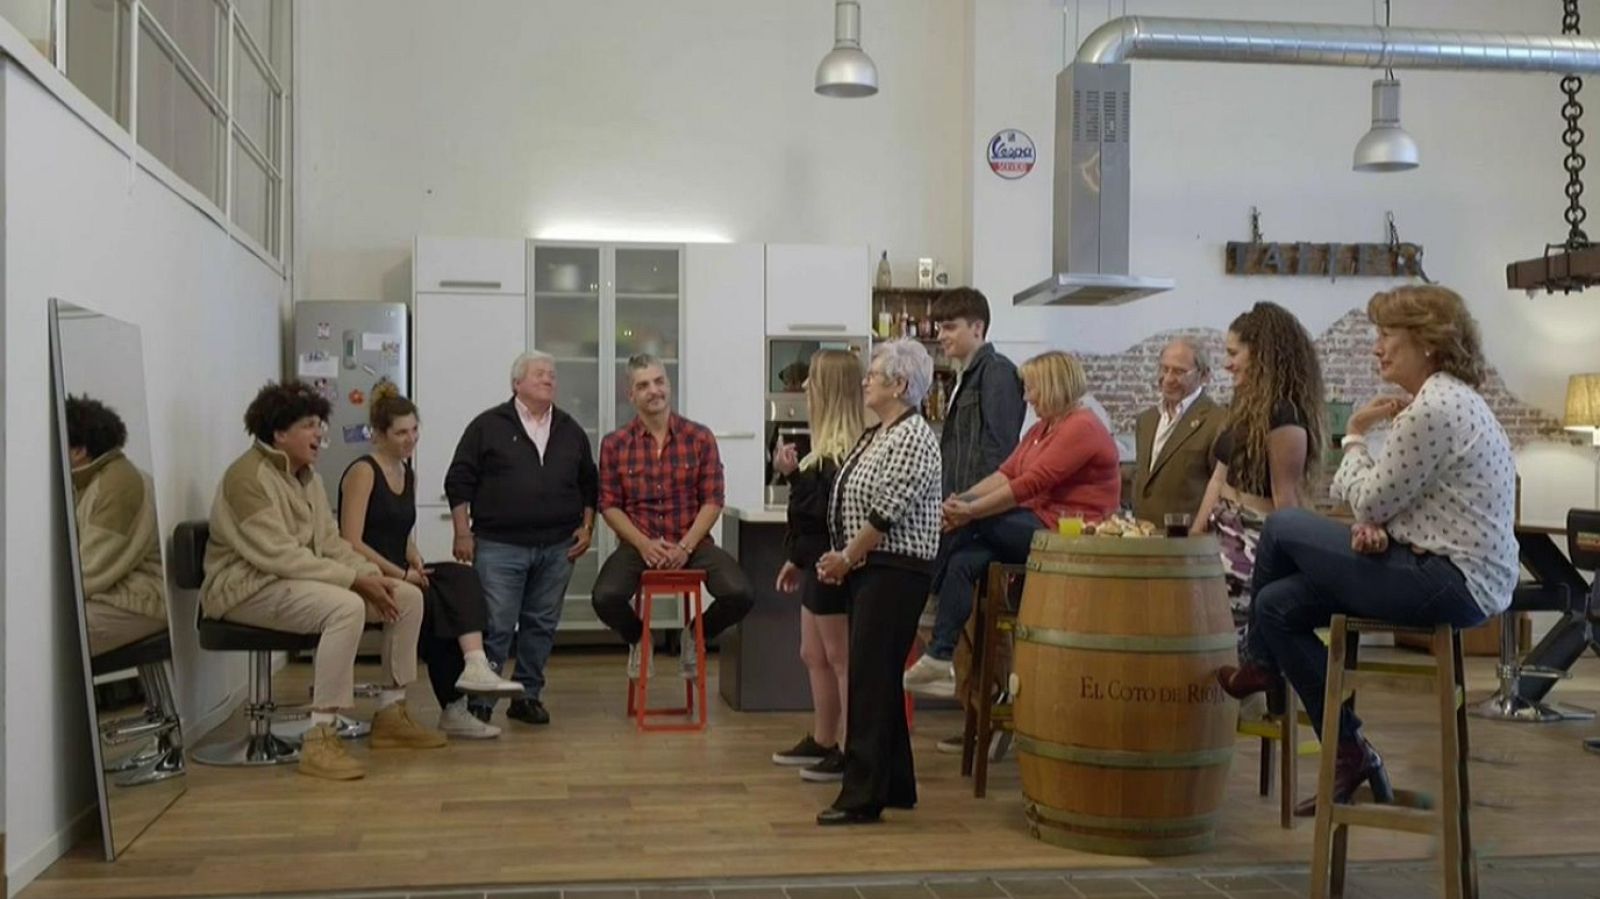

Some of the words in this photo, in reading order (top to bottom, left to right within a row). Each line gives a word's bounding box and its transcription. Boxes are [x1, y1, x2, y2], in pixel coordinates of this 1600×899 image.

[991, 135, 1033, 160] Vespa
[1080, 675, 1104, 700] EL
[1108, 679, 1156, 703] COTO
[1160, 687, 1182, 703] DE
